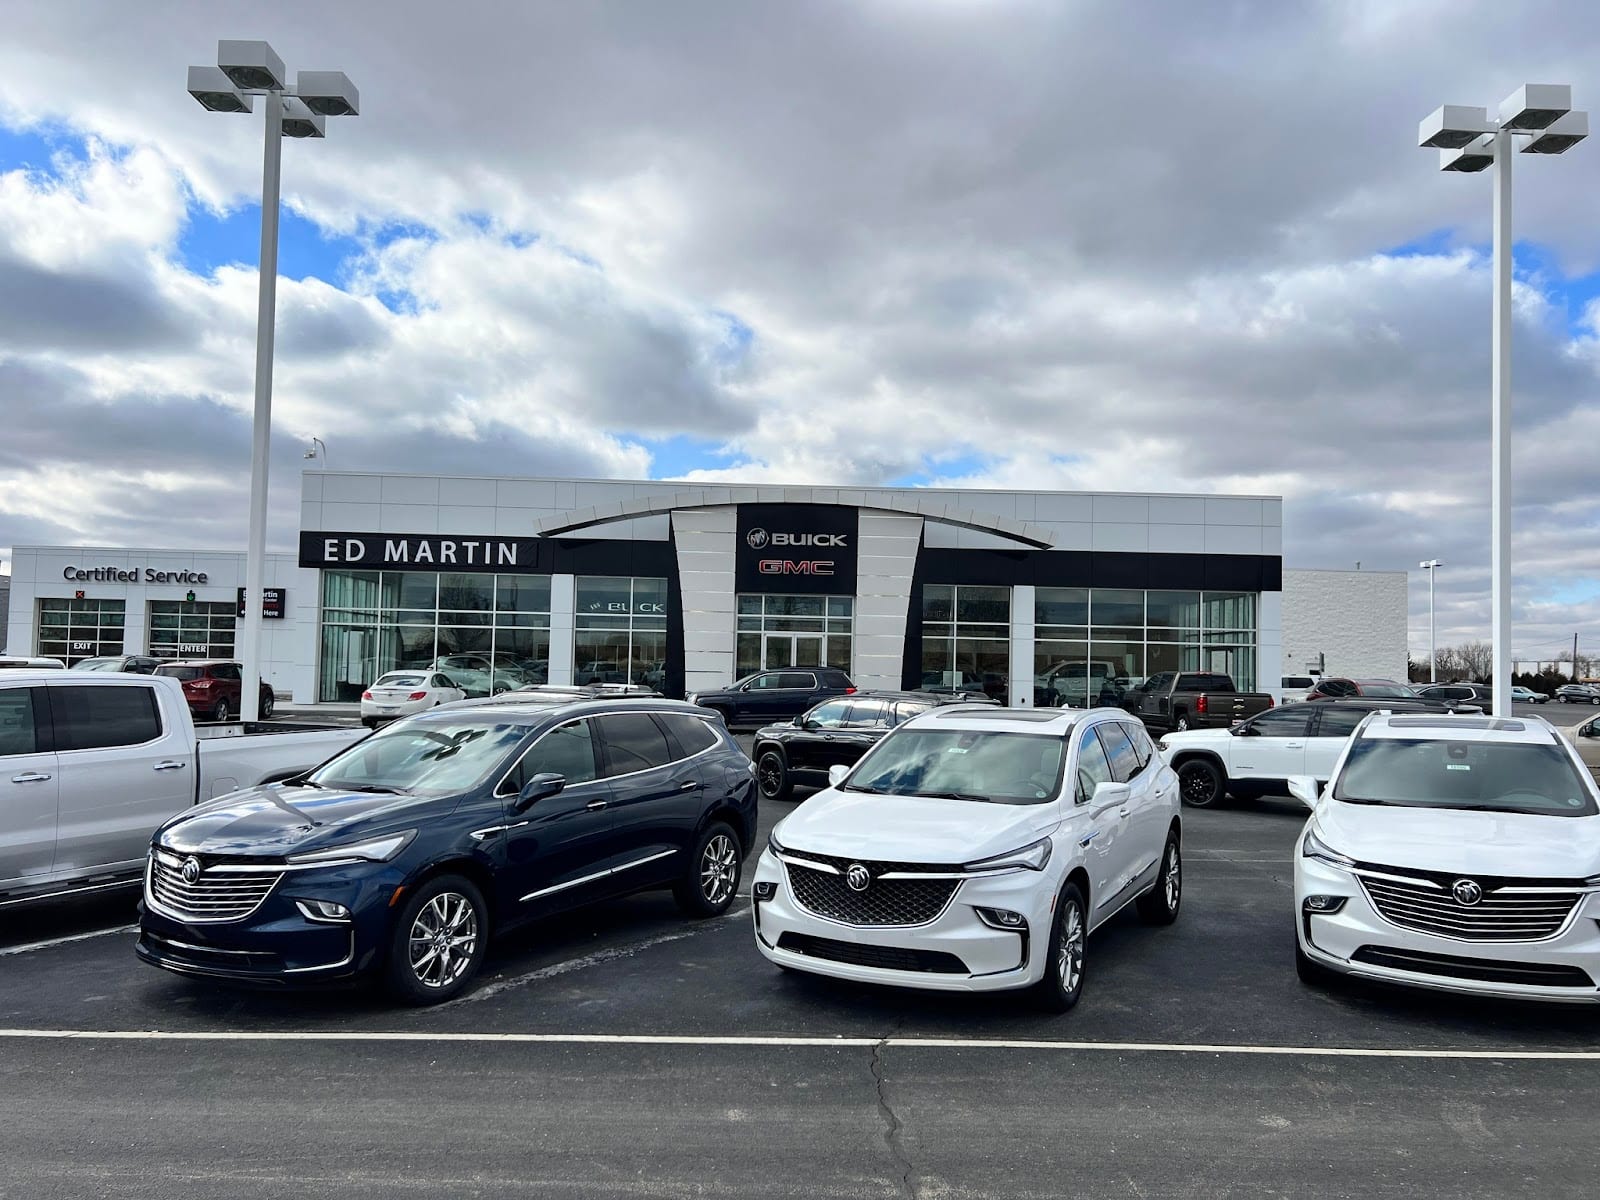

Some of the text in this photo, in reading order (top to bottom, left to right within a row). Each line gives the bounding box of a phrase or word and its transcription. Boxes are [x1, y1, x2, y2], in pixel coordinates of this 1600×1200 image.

[771, 532, 848, 547] BUICK
[324, 539, 518, 565] ED MARTIN
[63, 566, 208, 584] Certified Service
[758, 559, 835, 576] GMC
[73, 642, 91, 650] EXIT
[180, 644, 206, 652] ENTER
